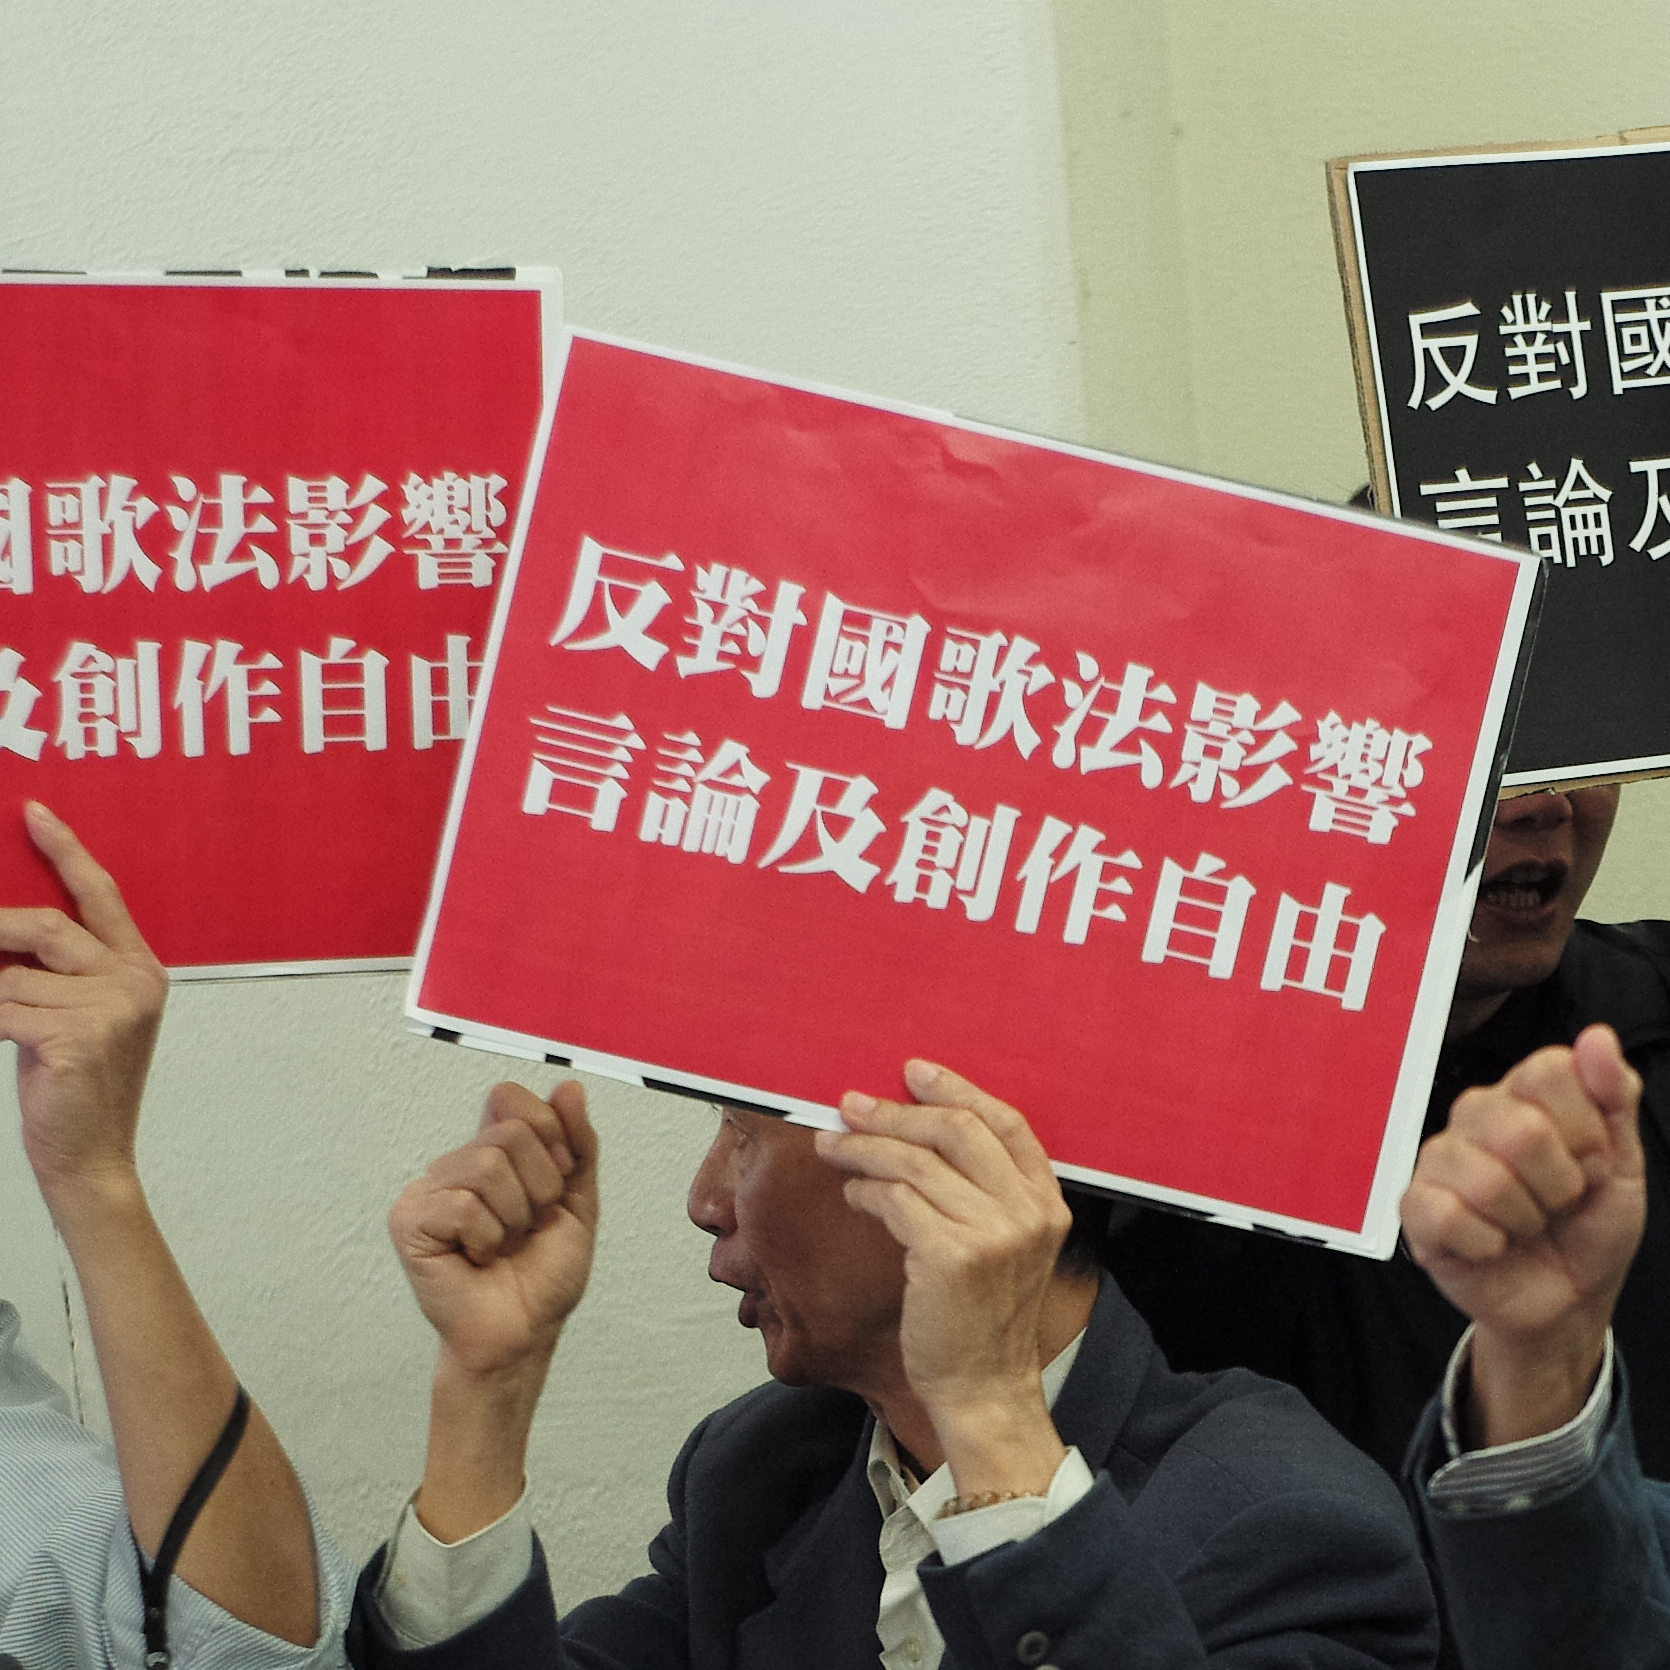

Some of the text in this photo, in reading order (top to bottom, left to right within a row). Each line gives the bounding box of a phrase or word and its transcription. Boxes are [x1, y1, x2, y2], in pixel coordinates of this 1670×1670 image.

[550, 536, 1433, 846] 反對國歌法影響
[521, 703, 1386, 1012] 言論及創作自由
